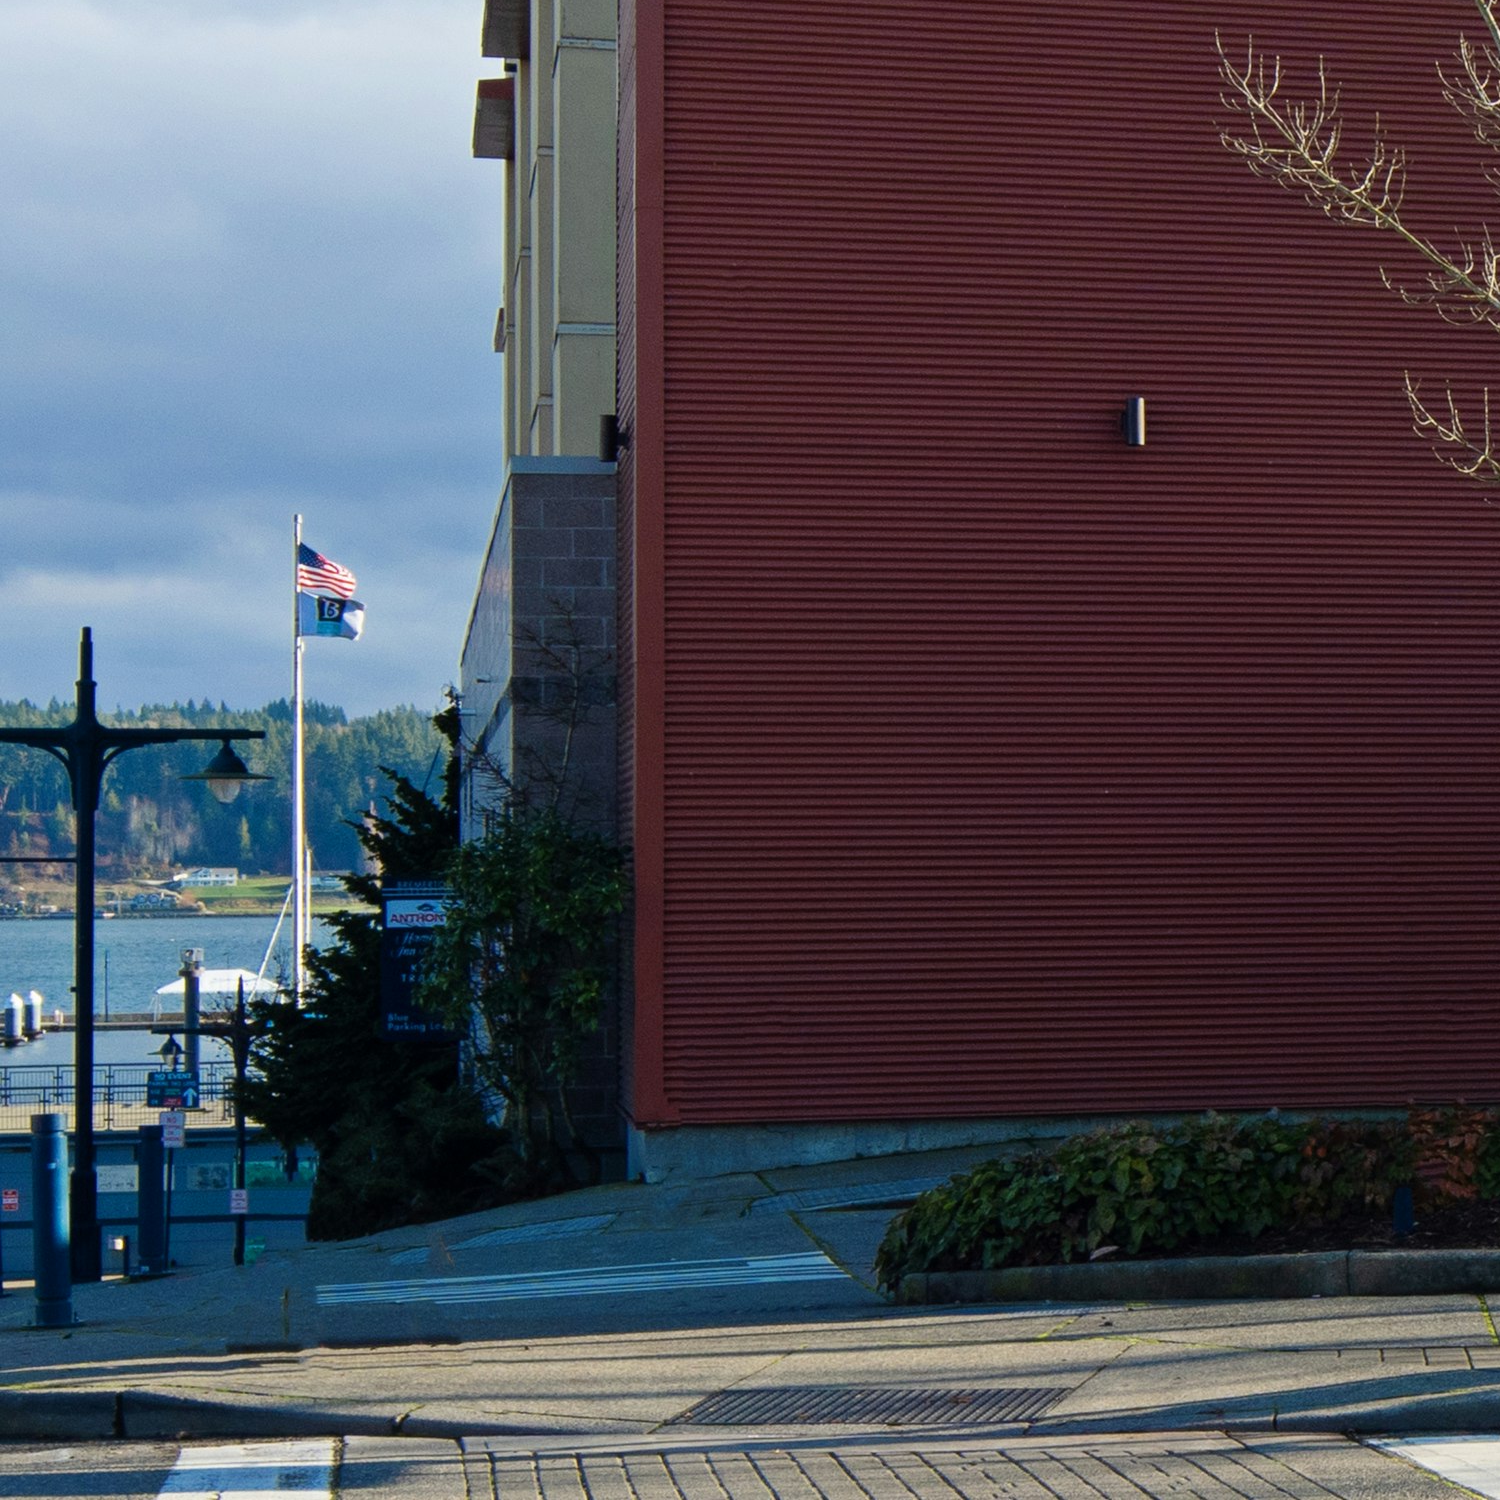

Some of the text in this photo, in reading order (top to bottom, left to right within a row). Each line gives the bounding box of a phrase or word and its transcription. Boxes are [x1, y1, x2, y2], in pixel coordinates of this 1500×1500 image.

[321, 598, 340, 619] B
[390, 913, 447, 923] ANTHON
[387, 1022, 426, 1033] Parking
